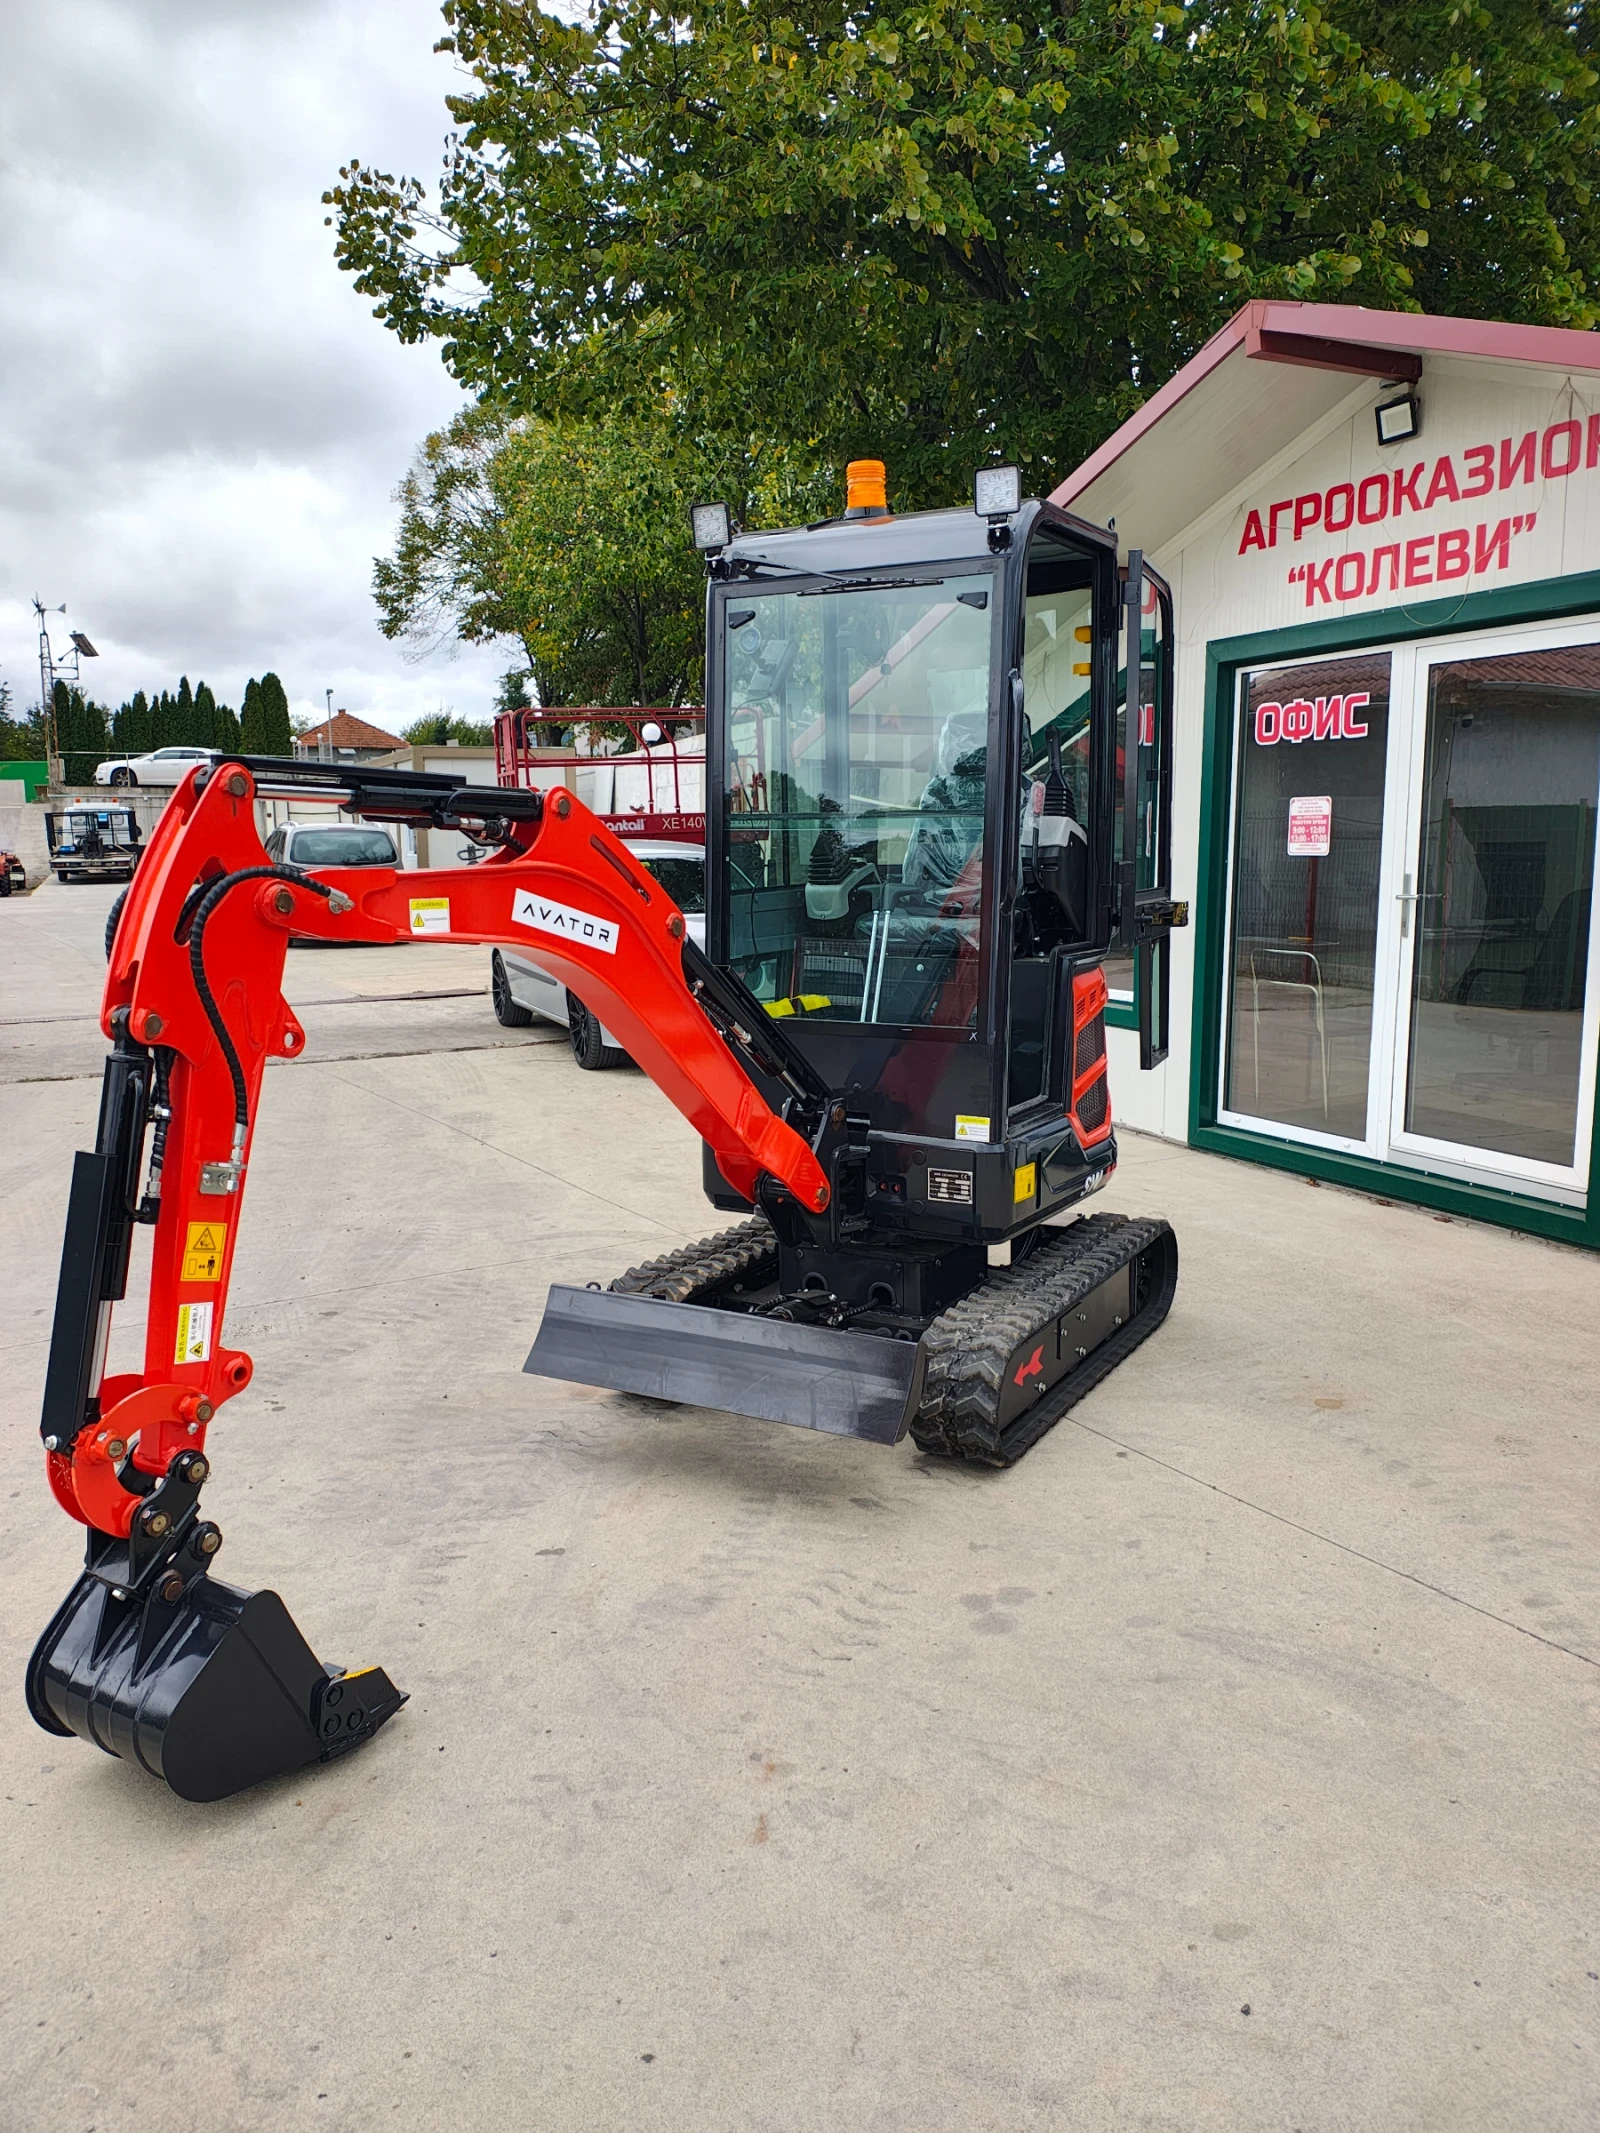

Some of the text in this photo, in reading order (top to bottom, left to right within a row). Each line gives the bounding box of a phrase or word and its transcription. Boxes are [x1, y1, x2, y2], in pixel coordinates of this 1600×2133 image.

[1255, 691, 1370, 745] ОФИС
[600, 818, 646, 832] antall
[523, 903, 610, 943] AVATOR
